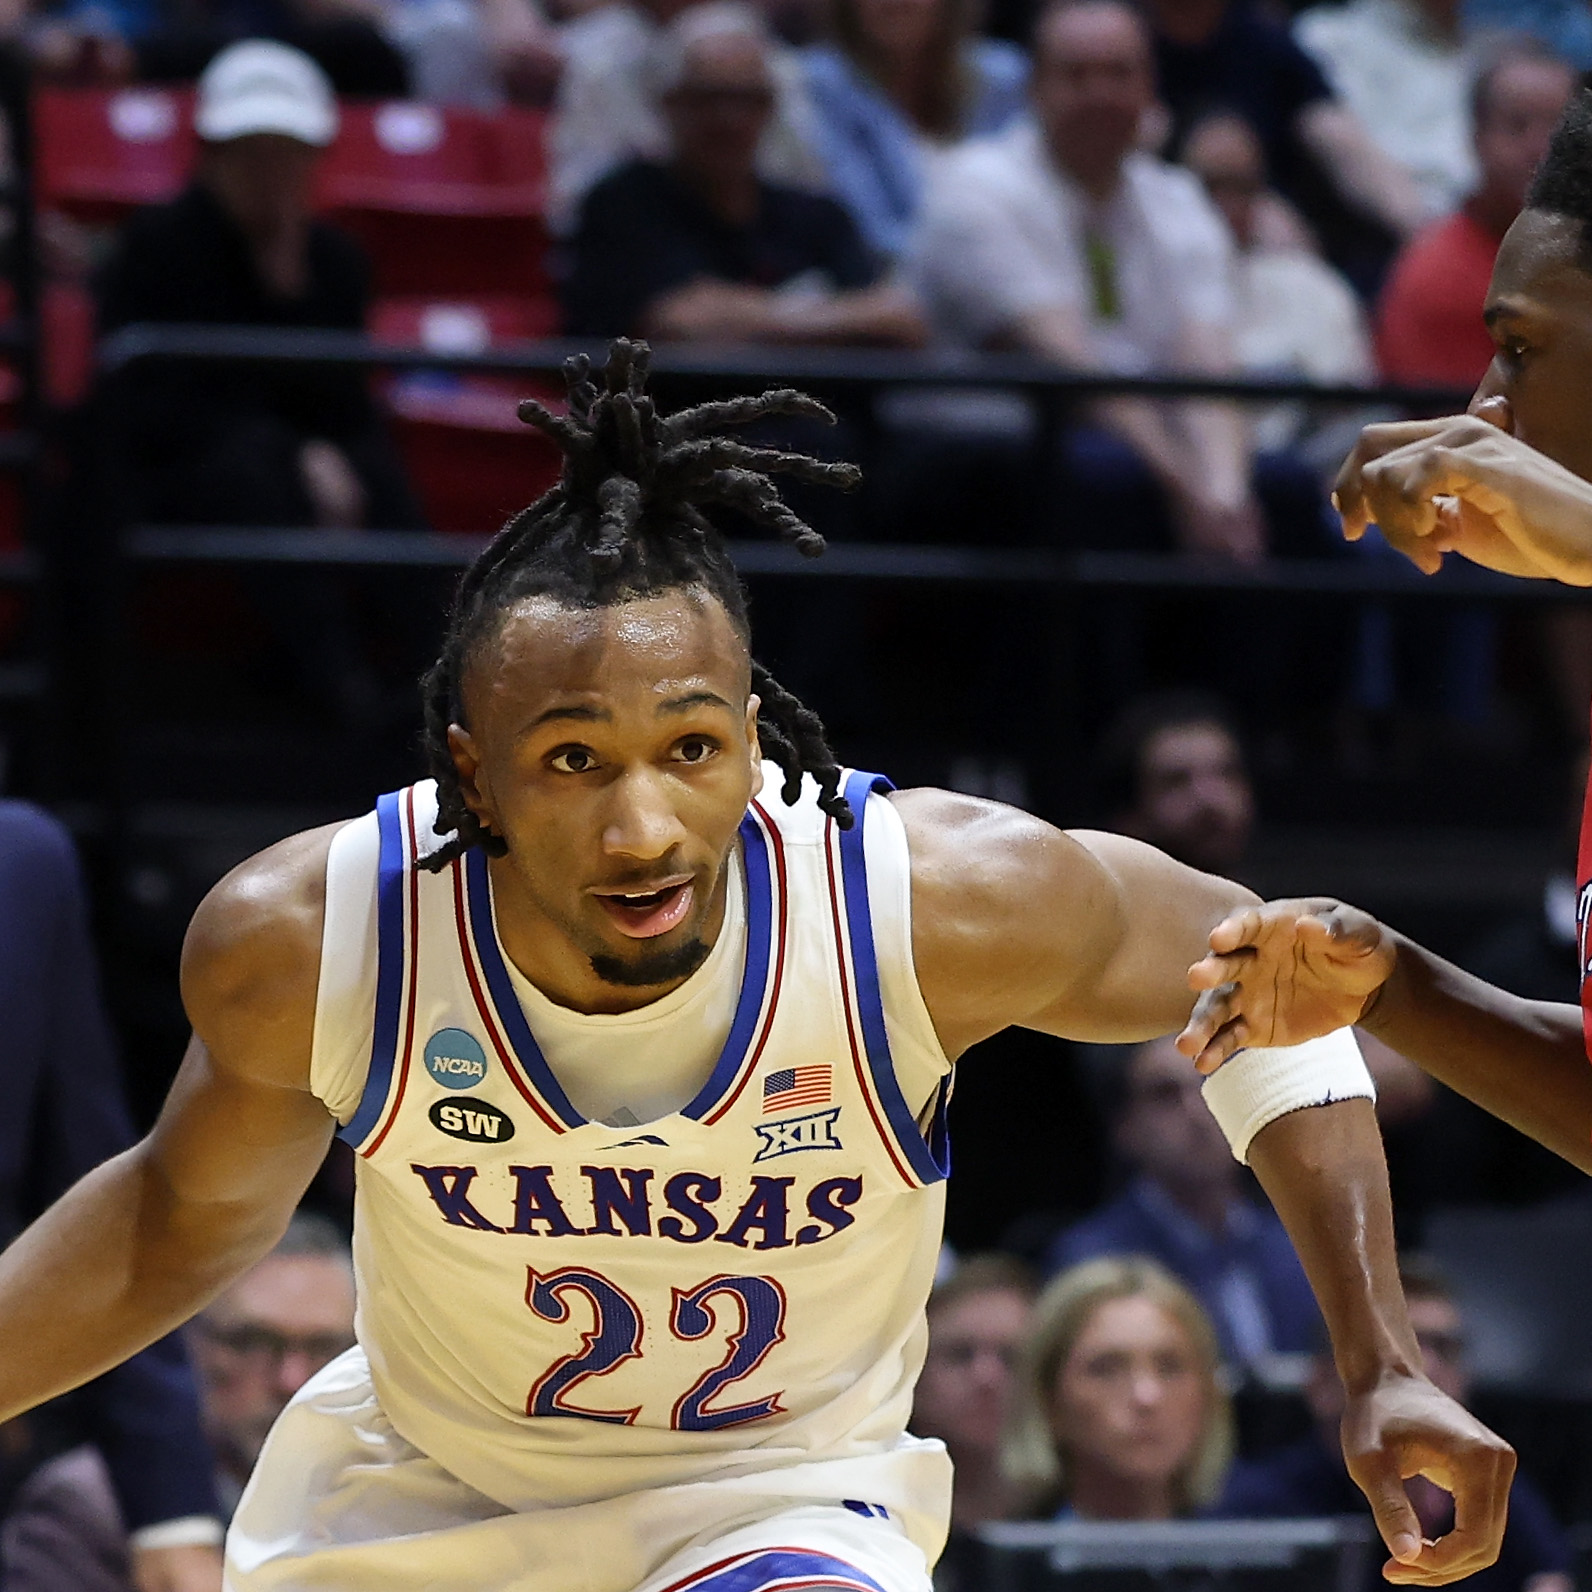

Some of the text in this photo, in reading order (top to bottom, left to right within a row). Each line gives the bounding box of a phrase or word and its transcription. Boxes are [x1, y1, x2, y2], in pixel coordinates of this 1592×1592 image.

[432, 1056, 484, 1078] NCAA
[439, 1105, 502, 1139] SW
[754, 1108, 841, 1163] XII
[409, 1163, 864, 1251] KANSAS
[525, 1264, 787, 1432] 22
